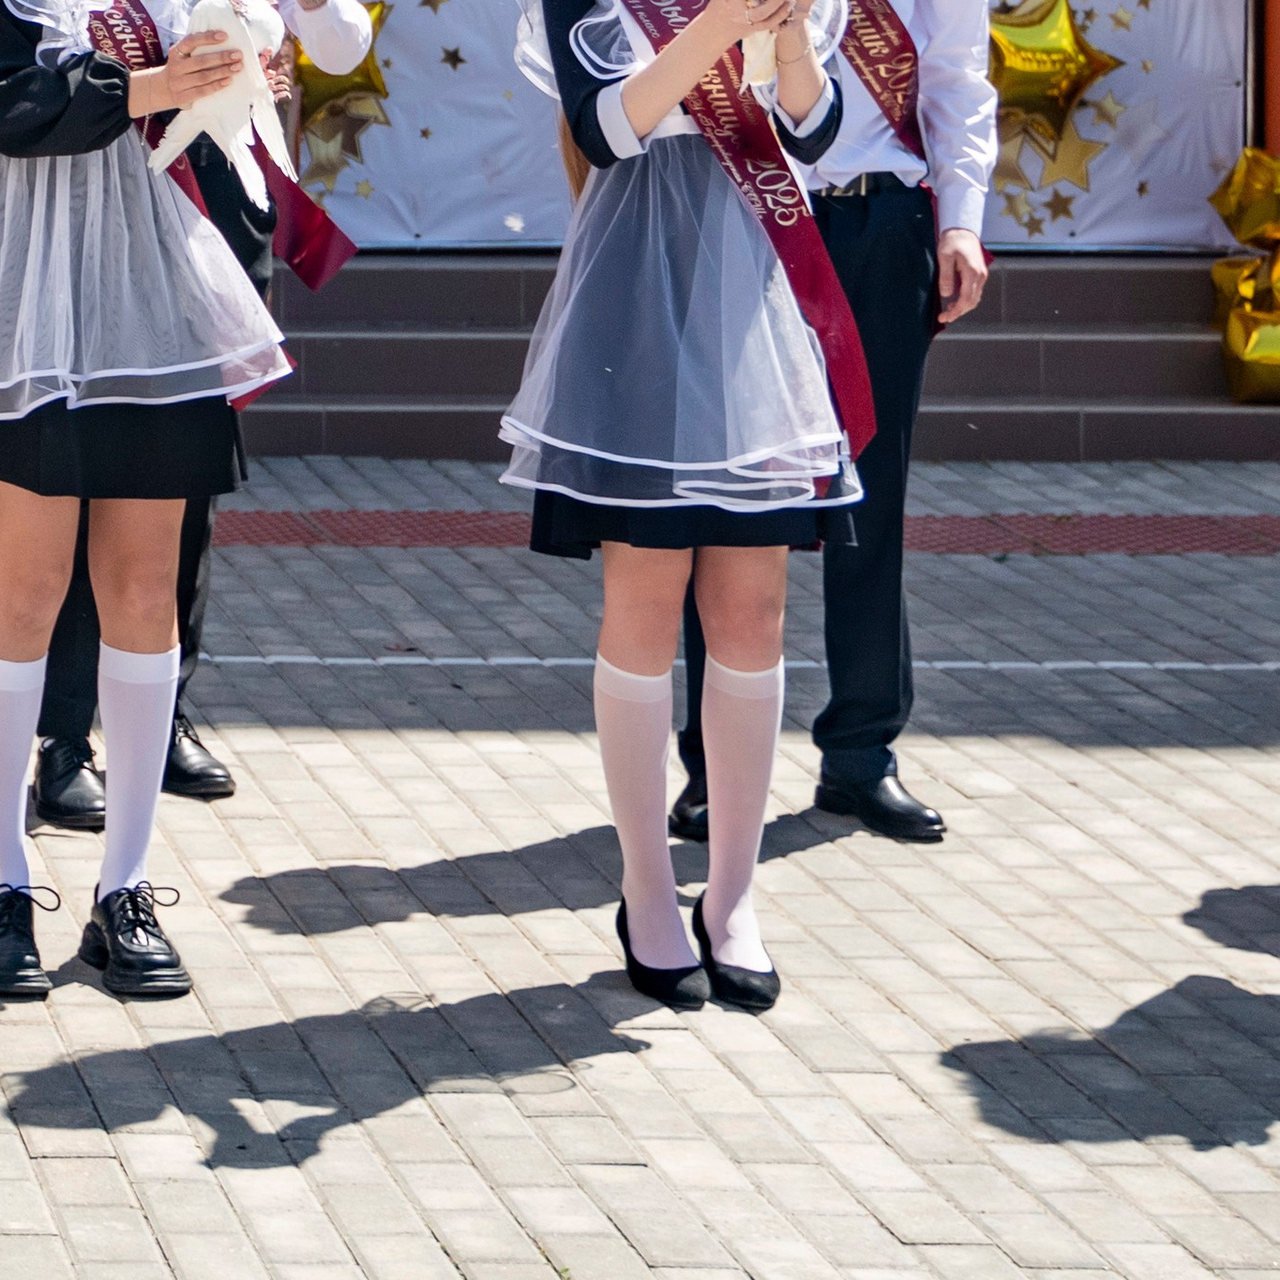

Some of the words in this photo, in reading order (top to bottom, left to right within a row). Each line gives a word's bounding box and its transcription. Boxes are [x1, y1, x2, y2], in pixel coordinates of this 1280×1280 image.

[628, 0, 643, 8] 11
[636, 11, 660, 38] класс
[746, 158, 809, 226] 2025
